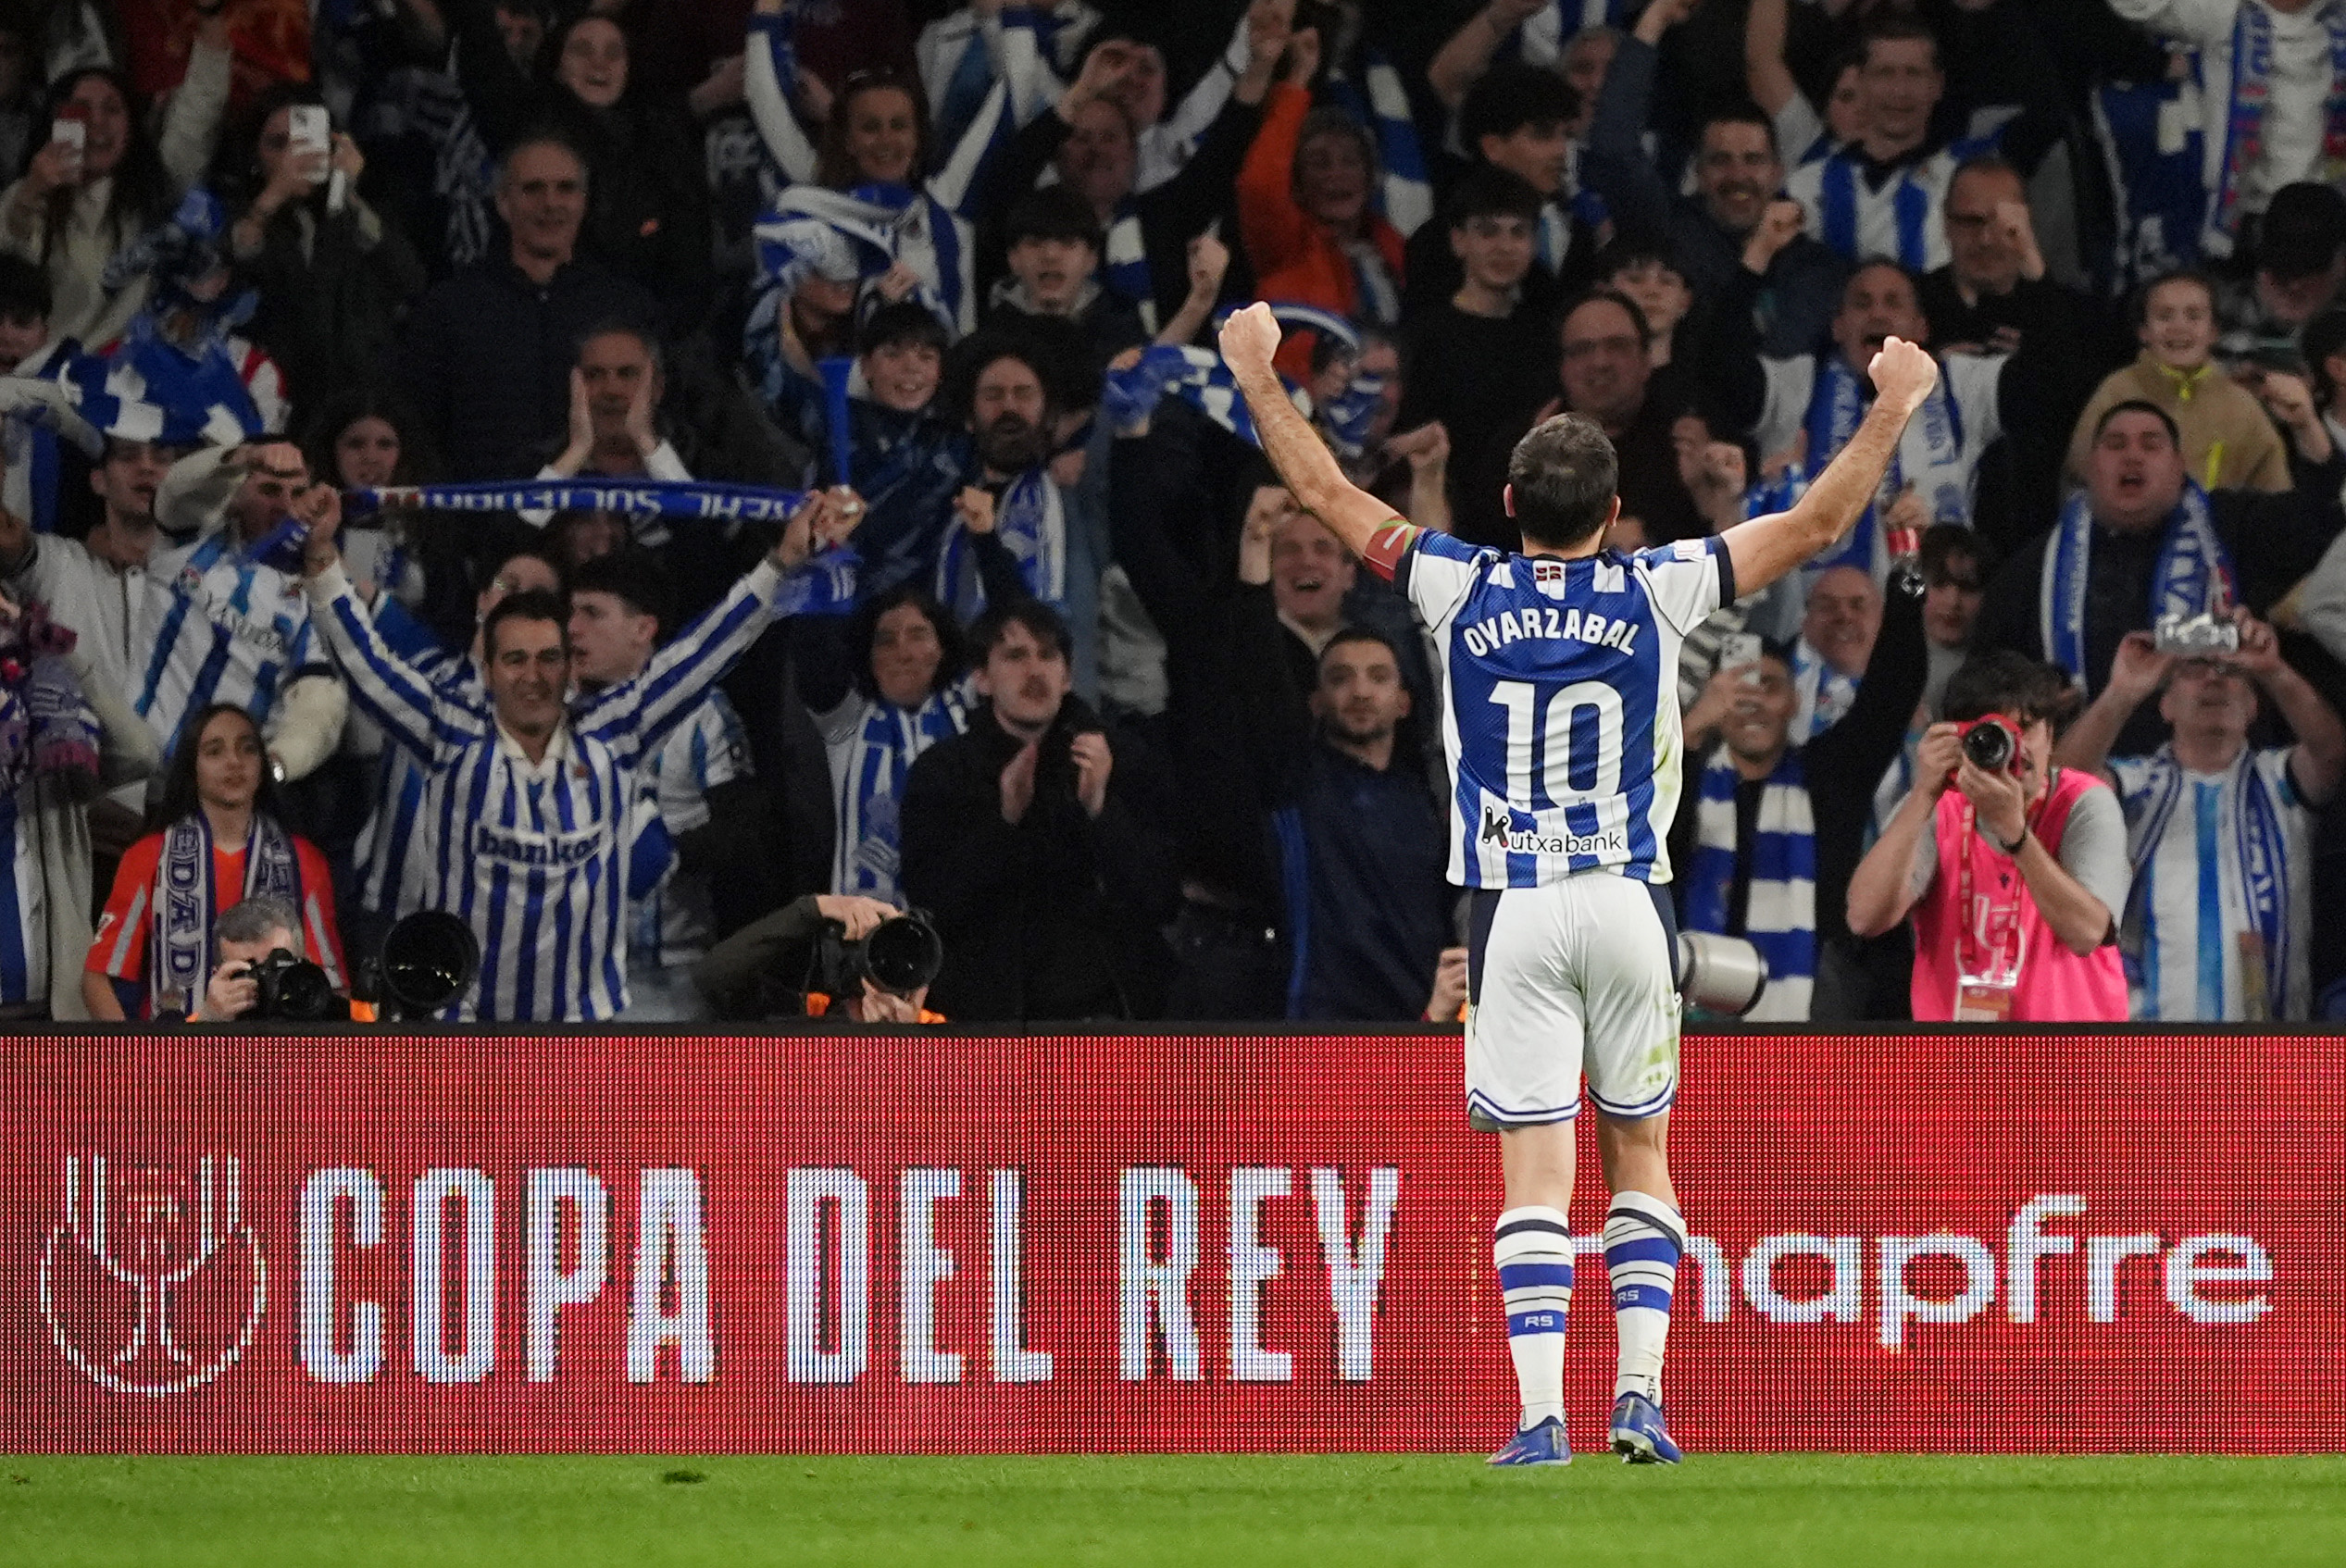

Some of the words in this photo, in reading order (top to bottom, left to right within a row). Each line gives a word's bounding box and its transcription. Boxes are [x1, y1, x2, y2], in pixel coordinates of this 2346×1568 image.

[1464, 608, 1639, 657] OYARZABAL
[1488, 680, 1624, 813] 10
[1481, 806, 1622, 853] Kutxabank
[298, 1166, 718, 1384] COPA
[786, 1166, 1054, 1383] DEL
[1118, 1166, 1399, 1381] REY
[1525, 1315, 1554, 1327] RS
